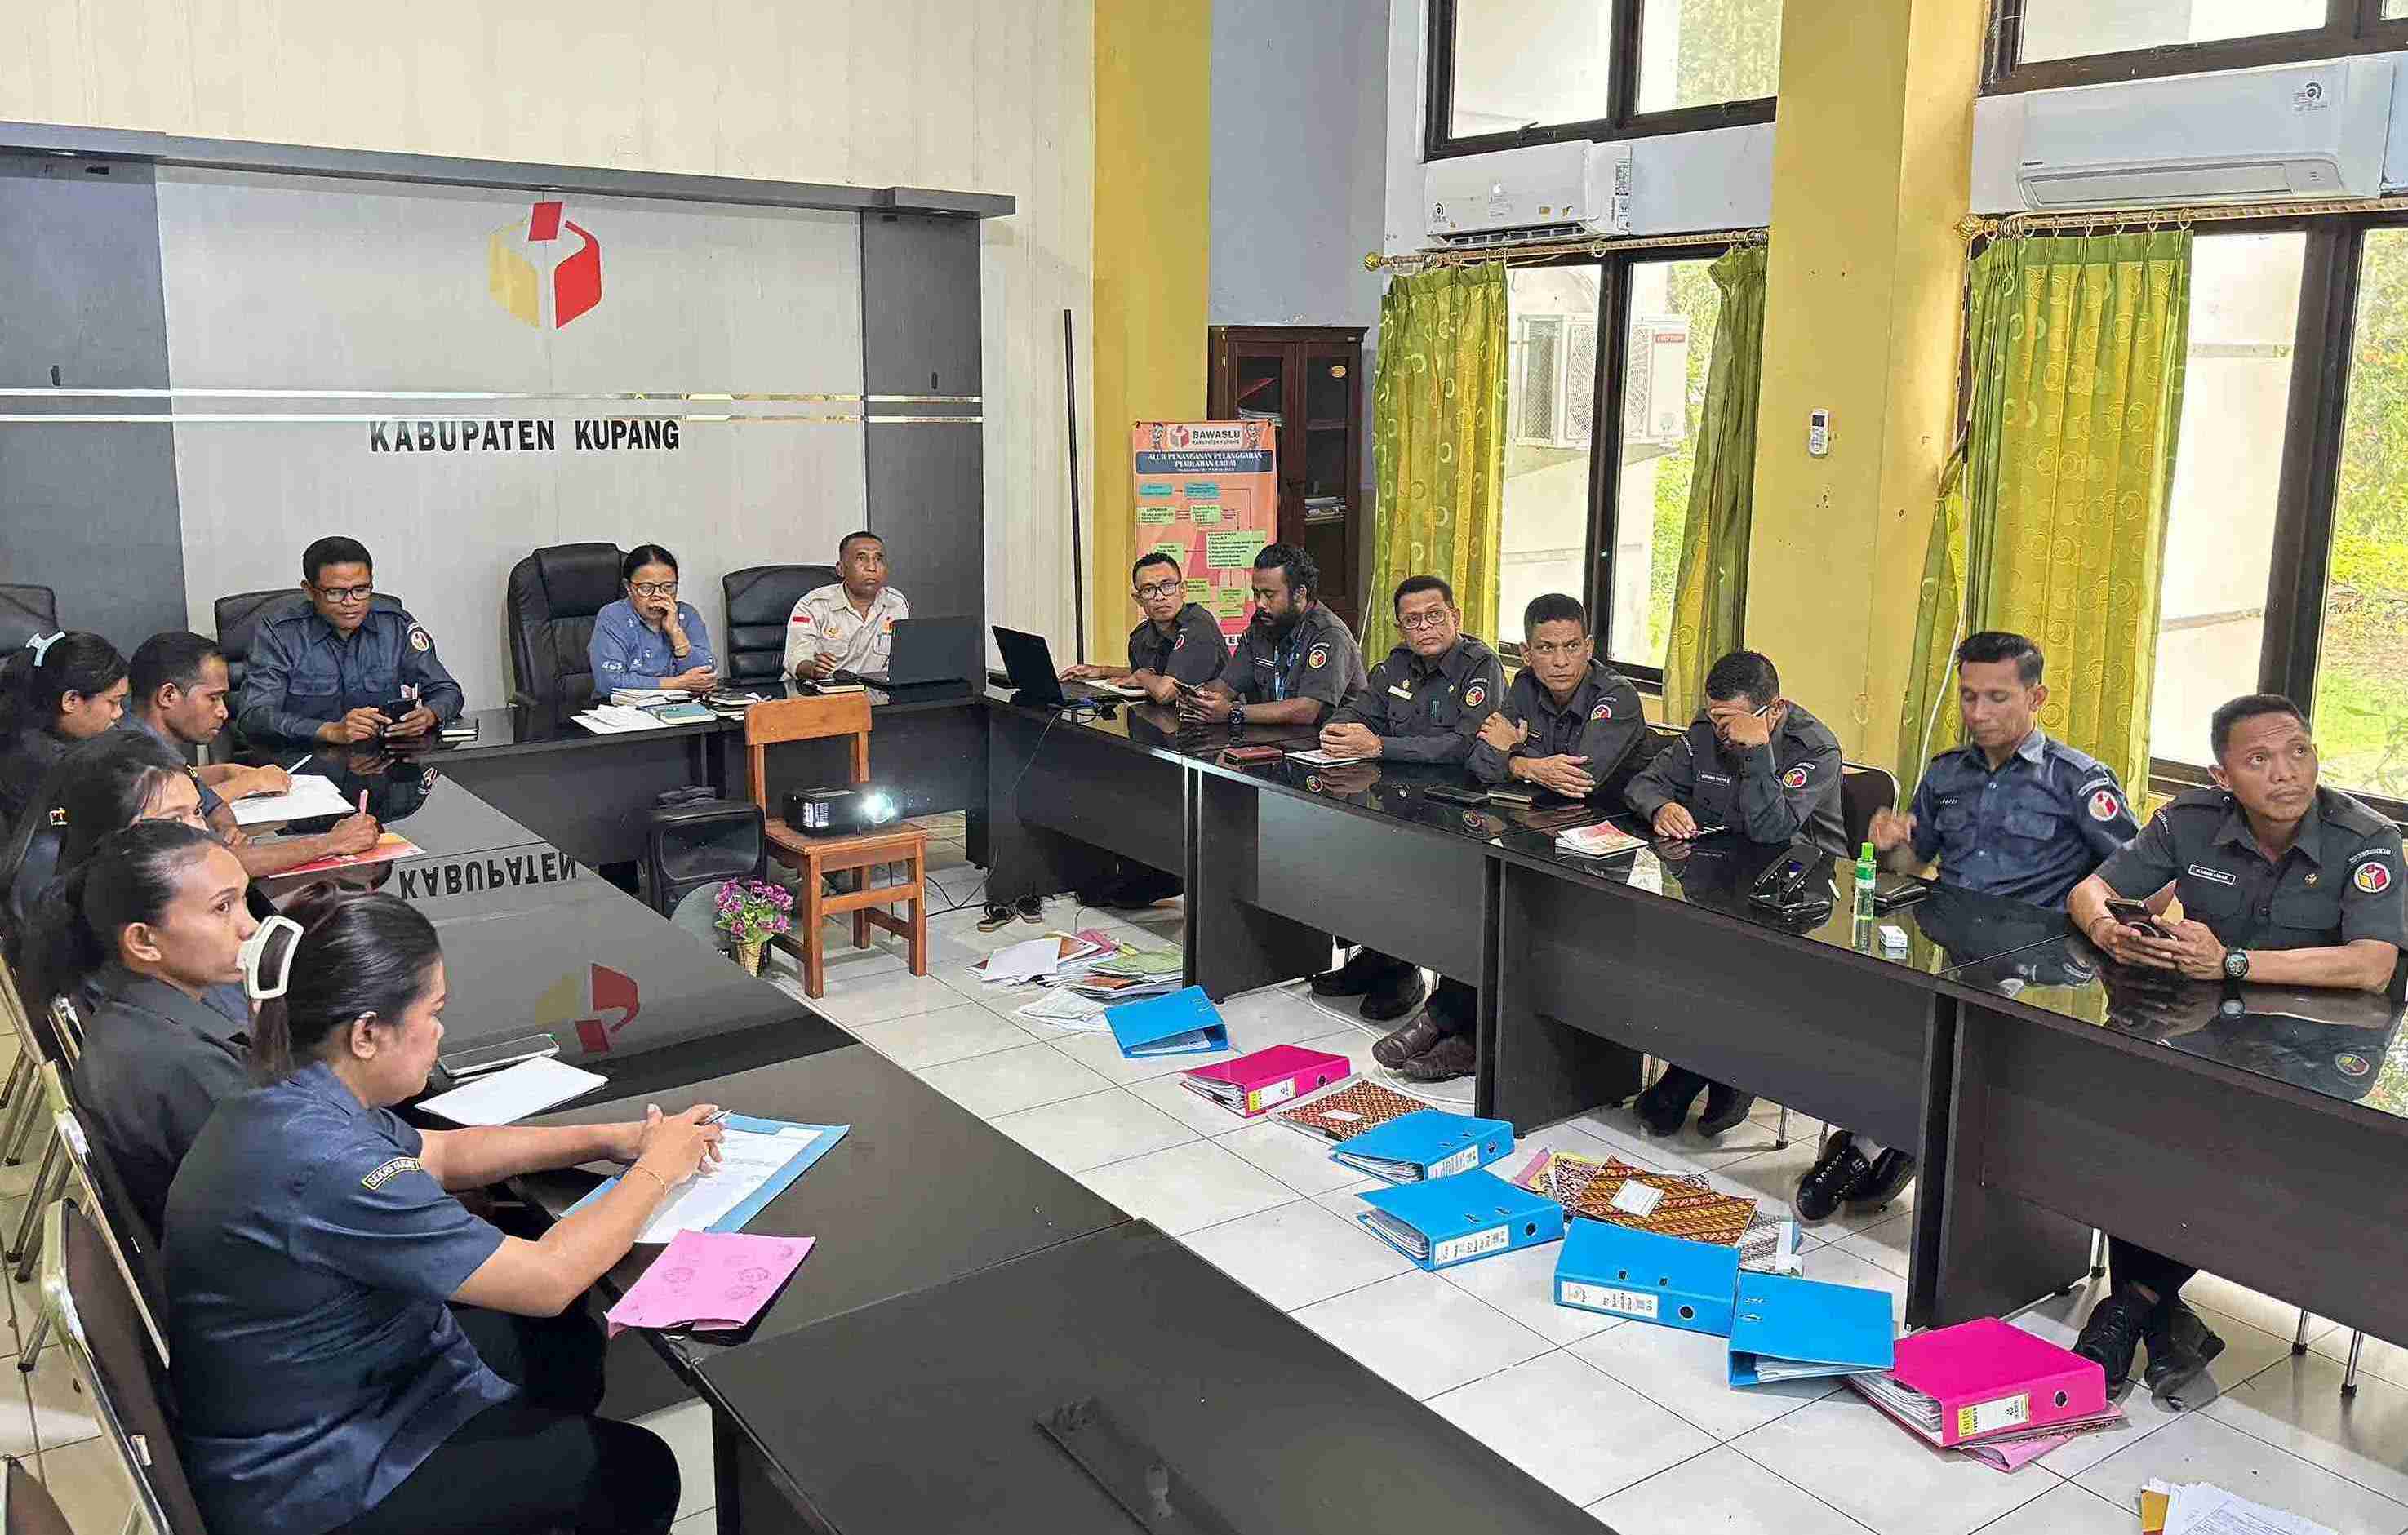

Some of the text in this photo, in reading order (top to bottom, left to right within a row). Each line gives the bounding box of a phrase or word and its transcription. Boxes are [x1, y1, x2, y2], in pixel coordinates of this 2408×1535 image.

[370, 419, 679, 451] KABUPATEN KUPANG
[1192, 430, 1241, 439] BAWASLU
